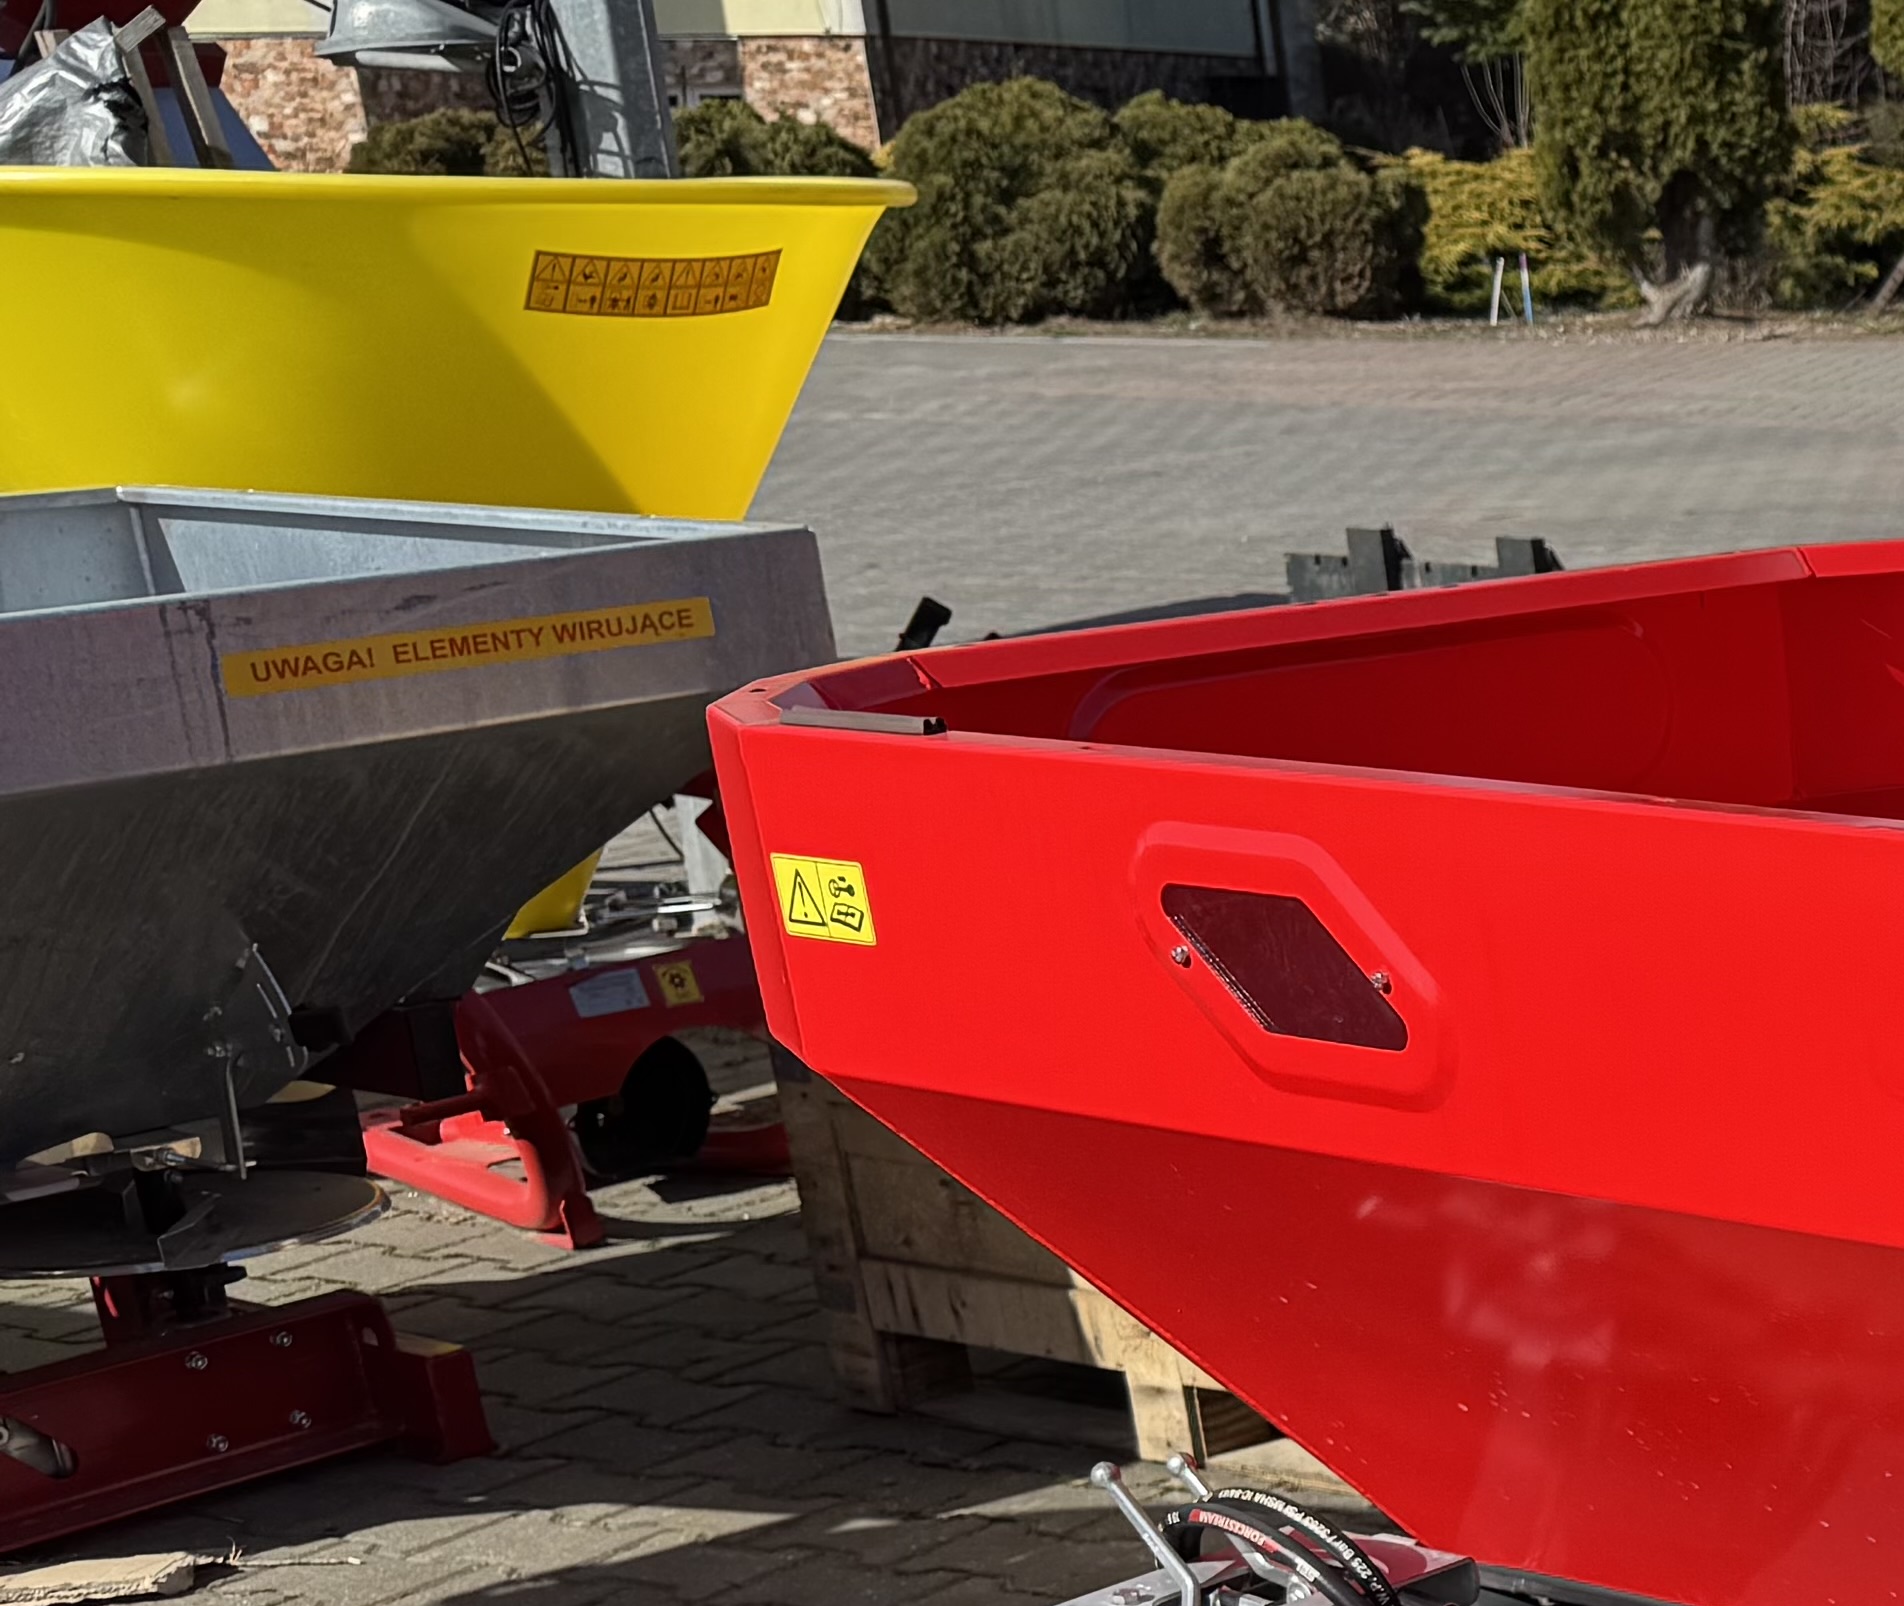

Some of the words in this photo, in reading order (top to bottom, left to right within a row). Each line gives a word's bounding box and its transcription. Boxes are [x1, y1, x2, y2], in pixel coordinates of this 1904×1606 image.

[250, 648, 375, 683] UWAGA!
[392, 626, 545, 665] ELEMENTY
[552, 608, 695, 644] WIRUJĄCE
[1254, 1491, 1287, 1512] MSHA
[1199, 1510, 1265, 1547] FORCESTREAM
[1334, 1542, 1355, 1561] Bar
[1350, 1557, 1373, 1580] 225
[1369, 1577, 1390, 1606] W.P.
